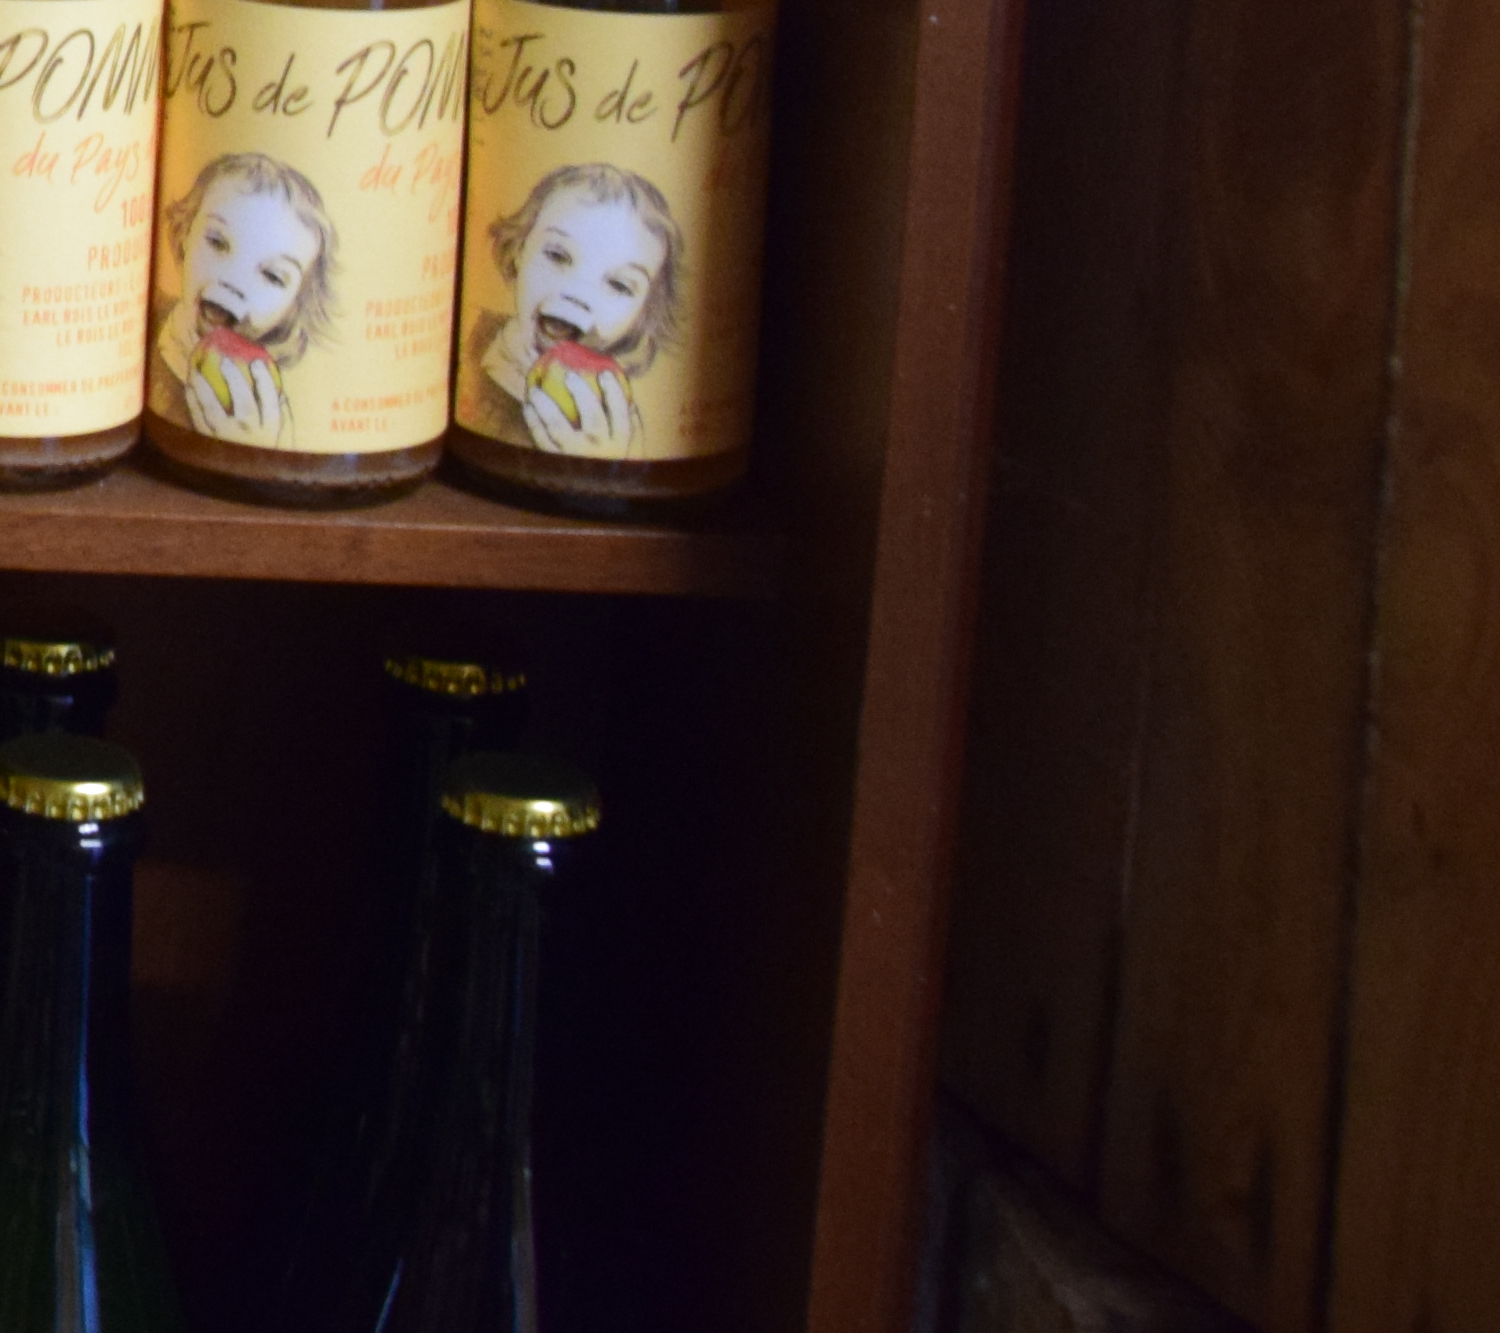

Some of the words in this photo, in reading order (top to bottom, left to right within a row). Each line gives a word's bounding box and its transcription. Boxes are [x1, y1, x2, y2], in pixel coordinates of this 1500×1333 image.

[165, 21, 237, 118] Jus
[253, 51, 313, 116] de
[482, 33, 576, 131] Jus
[595, 58, 656, 125] de
[12, 130, 59, 181] du
[71, 133, 142, 213] Pays
[358, 143, 402, 196] du
